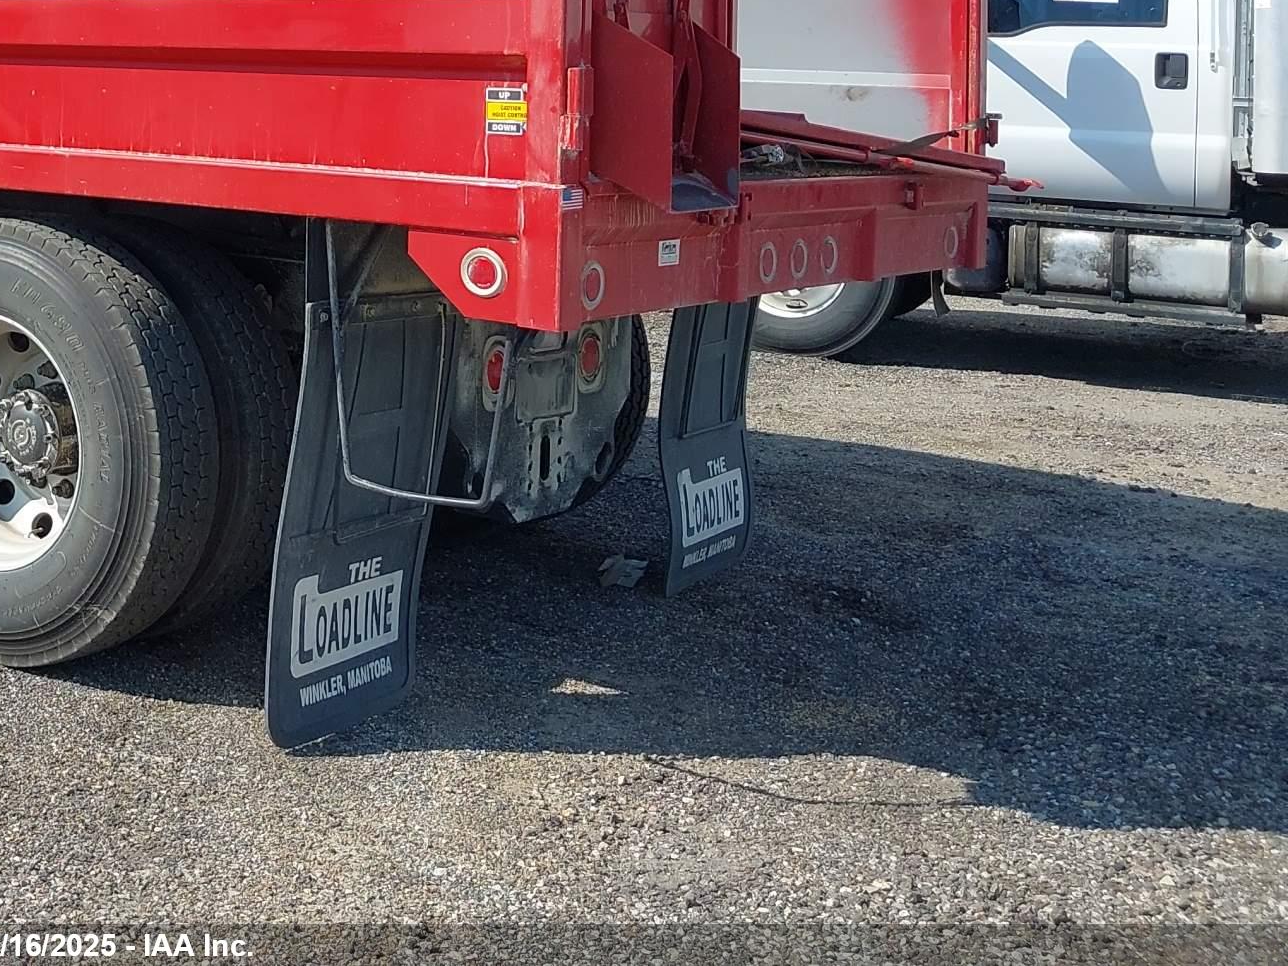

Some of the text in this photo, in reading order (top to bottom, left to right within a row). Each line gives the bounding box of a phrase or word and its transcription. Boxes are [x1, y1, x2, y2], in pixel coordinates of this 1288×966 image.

[498, 91, 511, 100] UP
[492, 124, 518, 132] DOWN
[706, 456, 728, 477] THE
[682, 479, 741, 538] LOADLINE
[349, 556, 383, 584] THE
[298, 584, 395, 665] LOADLINE
[299, 656, 393, 707] WINKLER, MANITOBA
